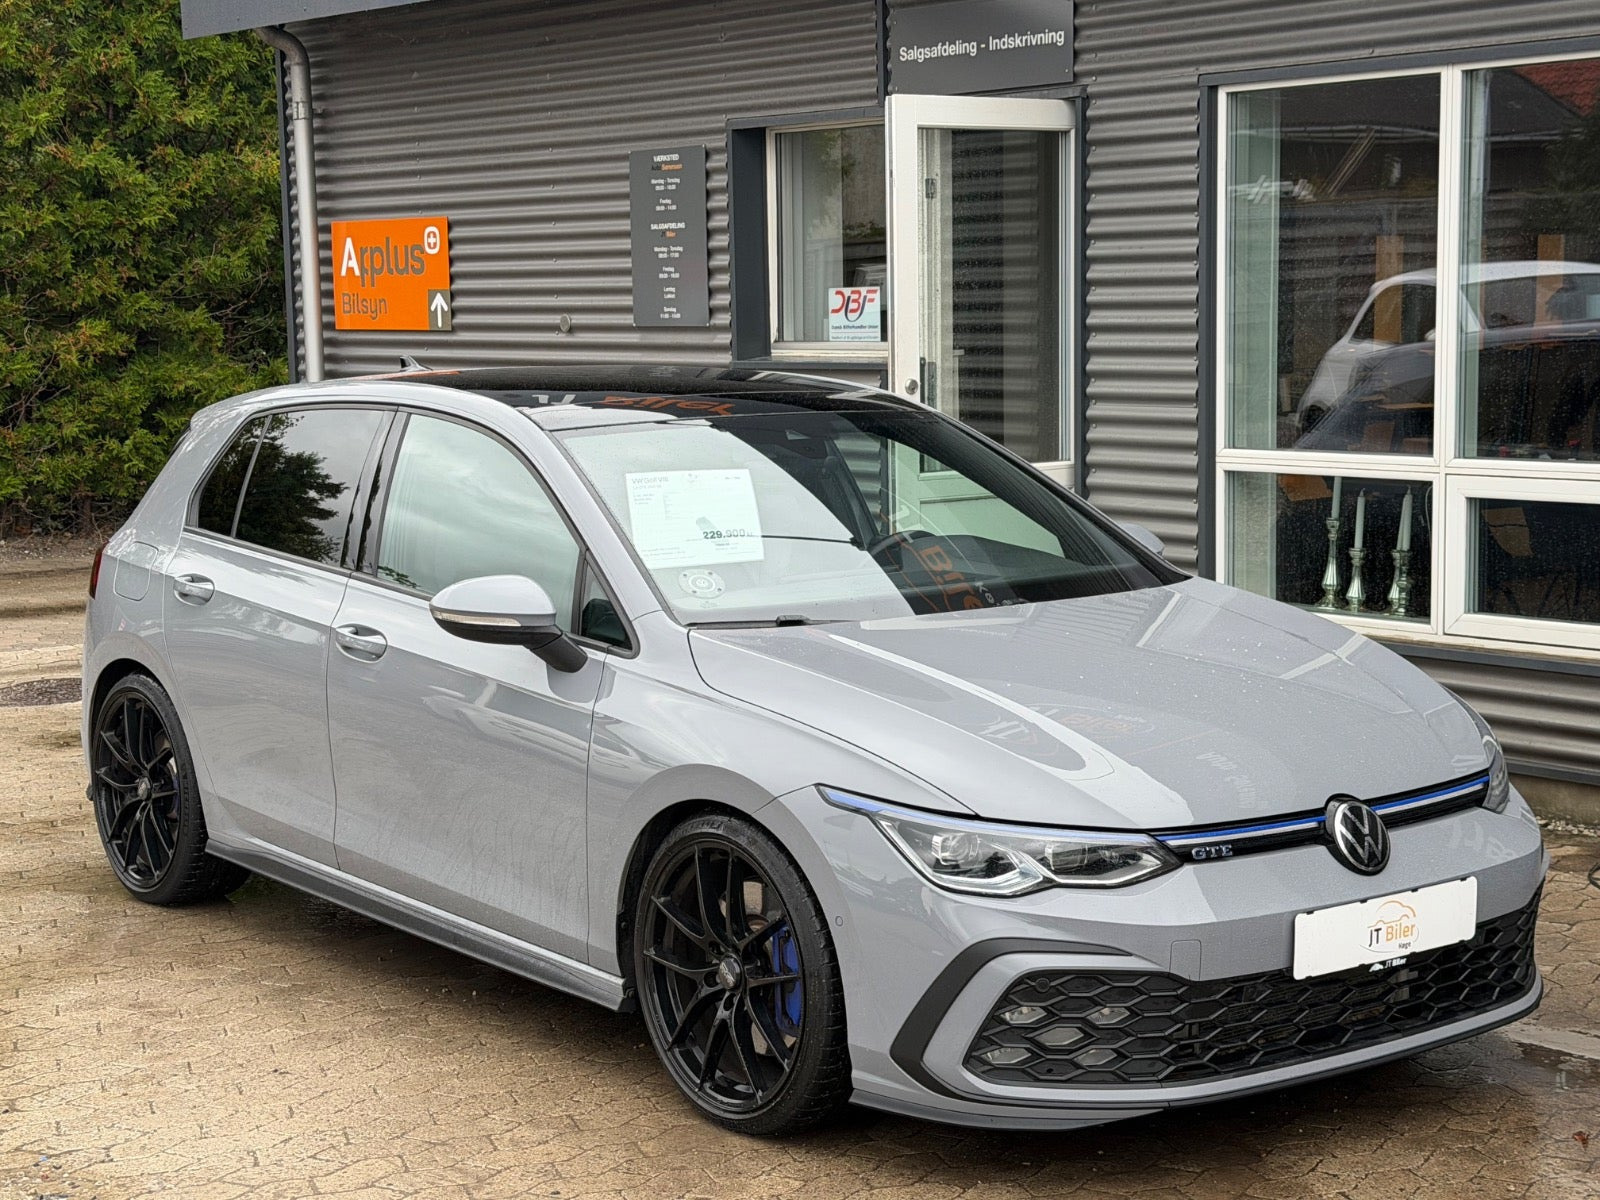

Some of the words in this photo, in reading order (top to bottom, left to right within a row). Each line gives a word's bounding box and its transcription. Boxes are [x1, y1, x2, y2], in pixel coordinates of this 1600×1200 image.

[899, 40, 977, 63] Salgsafdeling
[989, 29, 1065, 50] Indskrivning
[341, 237, 426, 288] Applus
[342, 292, 388, 321] Bilsyn
[702, 528, 746, 540] 229.900
[1191, 844, 1233, 860] GTE
[1368, 927, 1383, 948] JT
[1385, 922, 1416, 942] Biler
